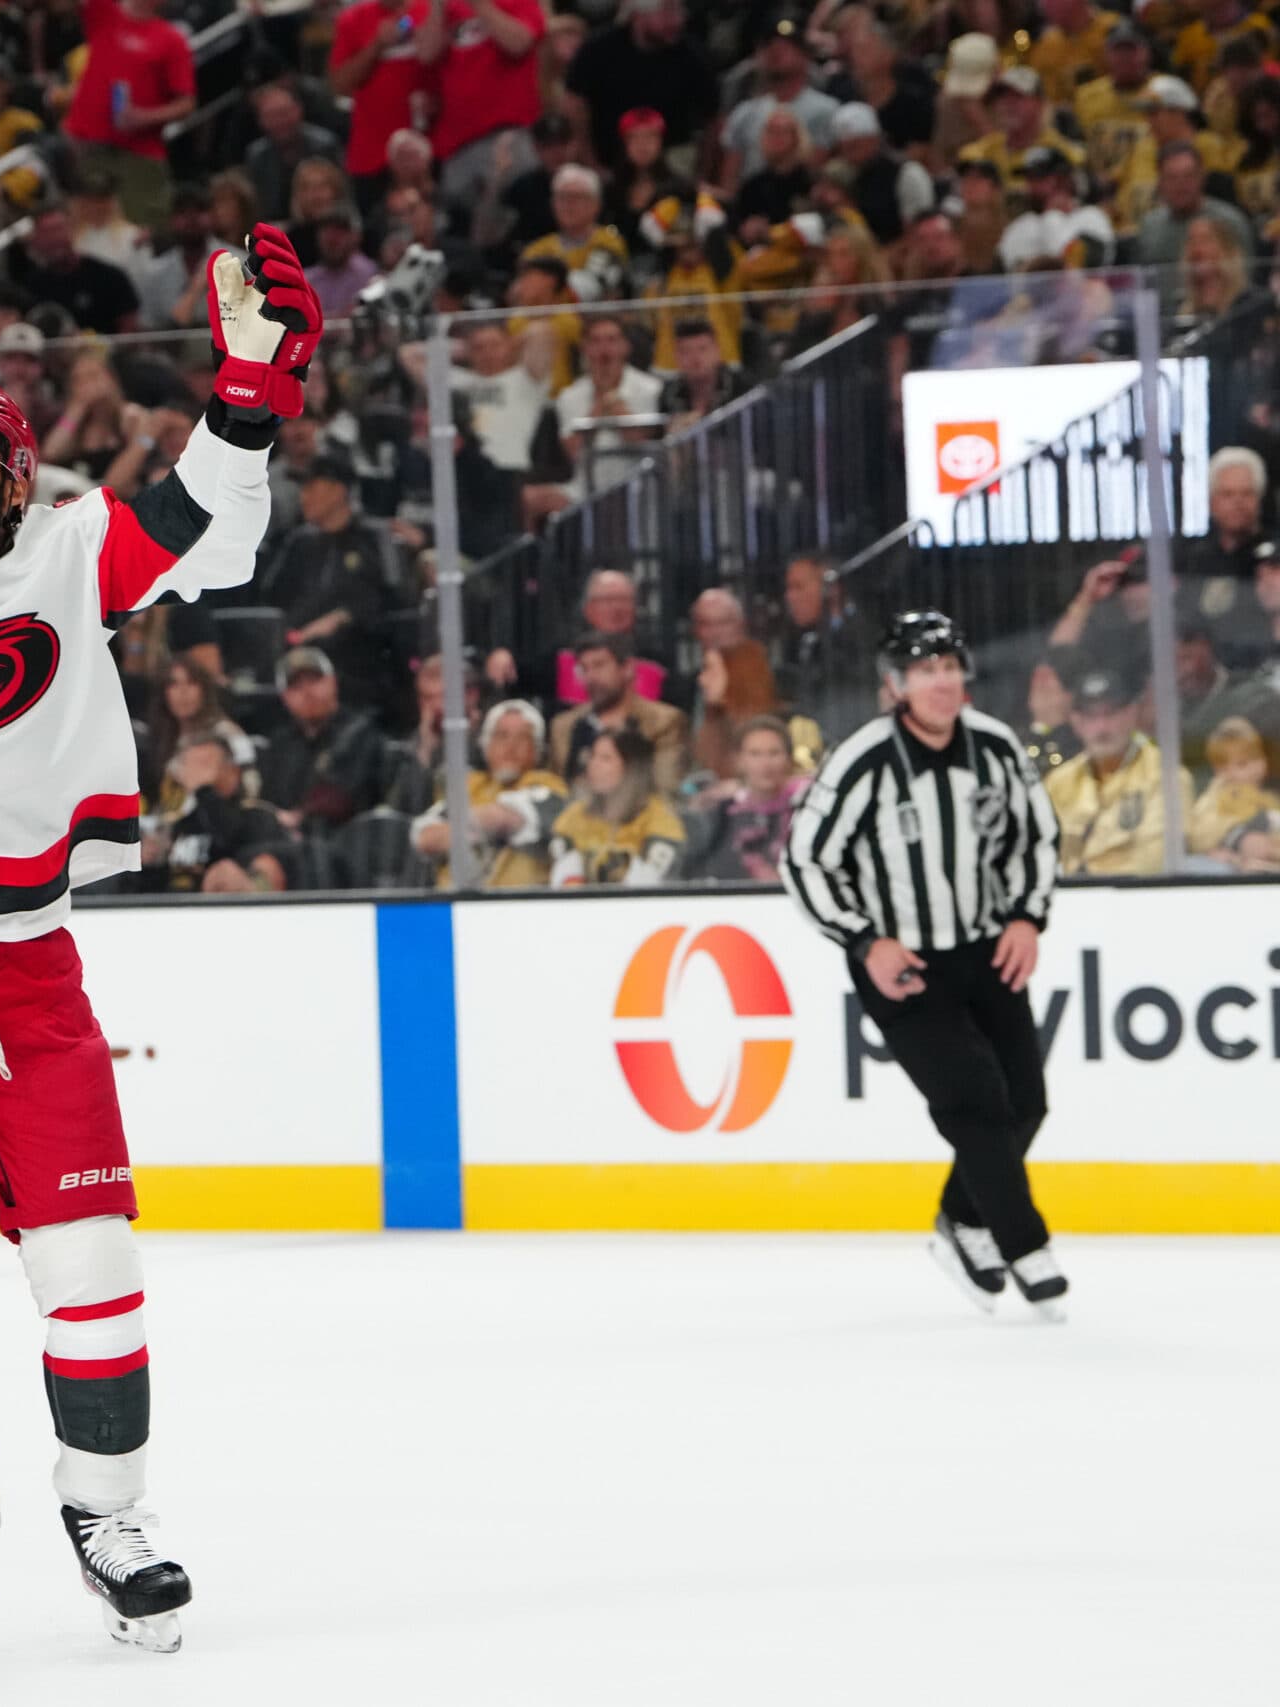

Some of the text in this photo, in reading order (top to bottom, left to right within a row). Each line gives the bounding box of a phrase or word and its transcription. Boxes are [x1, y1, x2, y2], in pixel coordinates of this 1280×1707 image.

[226, 385, 257, 398] MACH
[844, 946, 1280, 1099] pyloci
[87, 1570, 110, 1595] CCM
